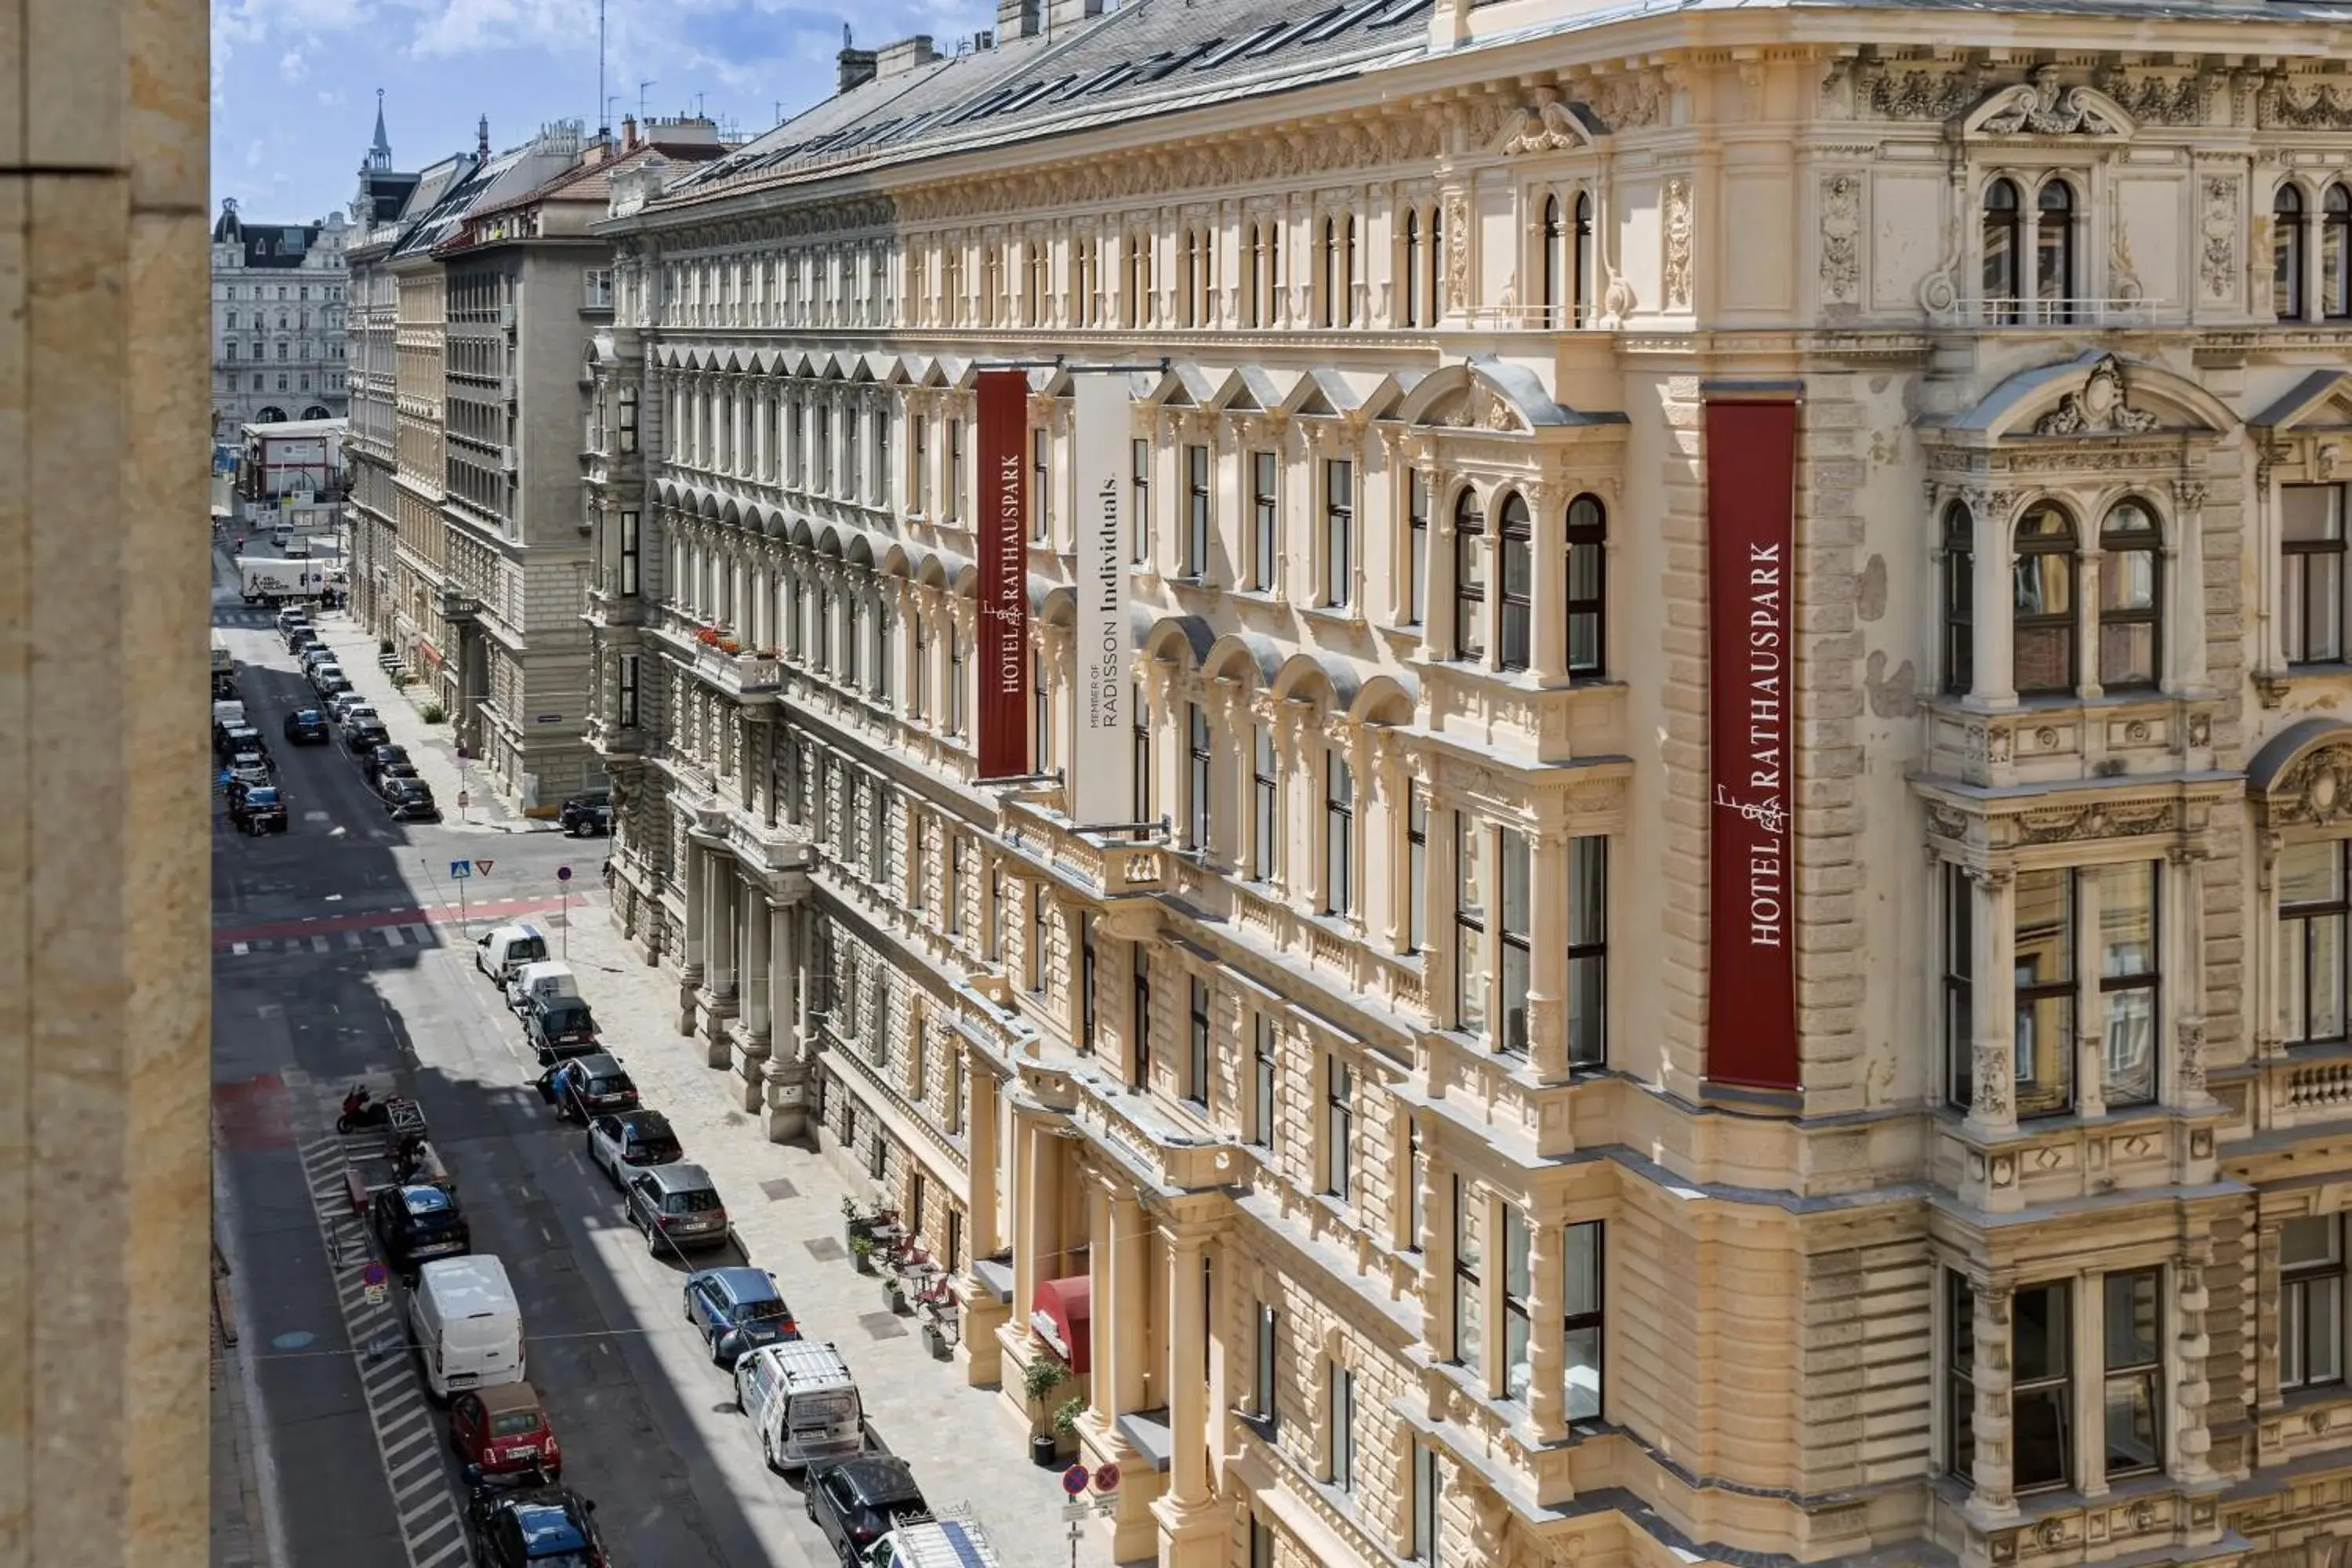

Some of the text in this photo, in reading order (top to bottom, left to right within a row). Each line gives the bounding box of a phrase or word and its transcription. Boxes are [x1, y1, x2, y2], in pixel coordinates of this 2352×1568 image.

[1001, 454, 1019, 693] HOTEL RATHAUSPARK
[1091, 664, 1099, 678] OF
[1103, 622, 1117, 728] RADISSON
[1750, 542, 1780, 947] HOTEL RATHAUSPARK
